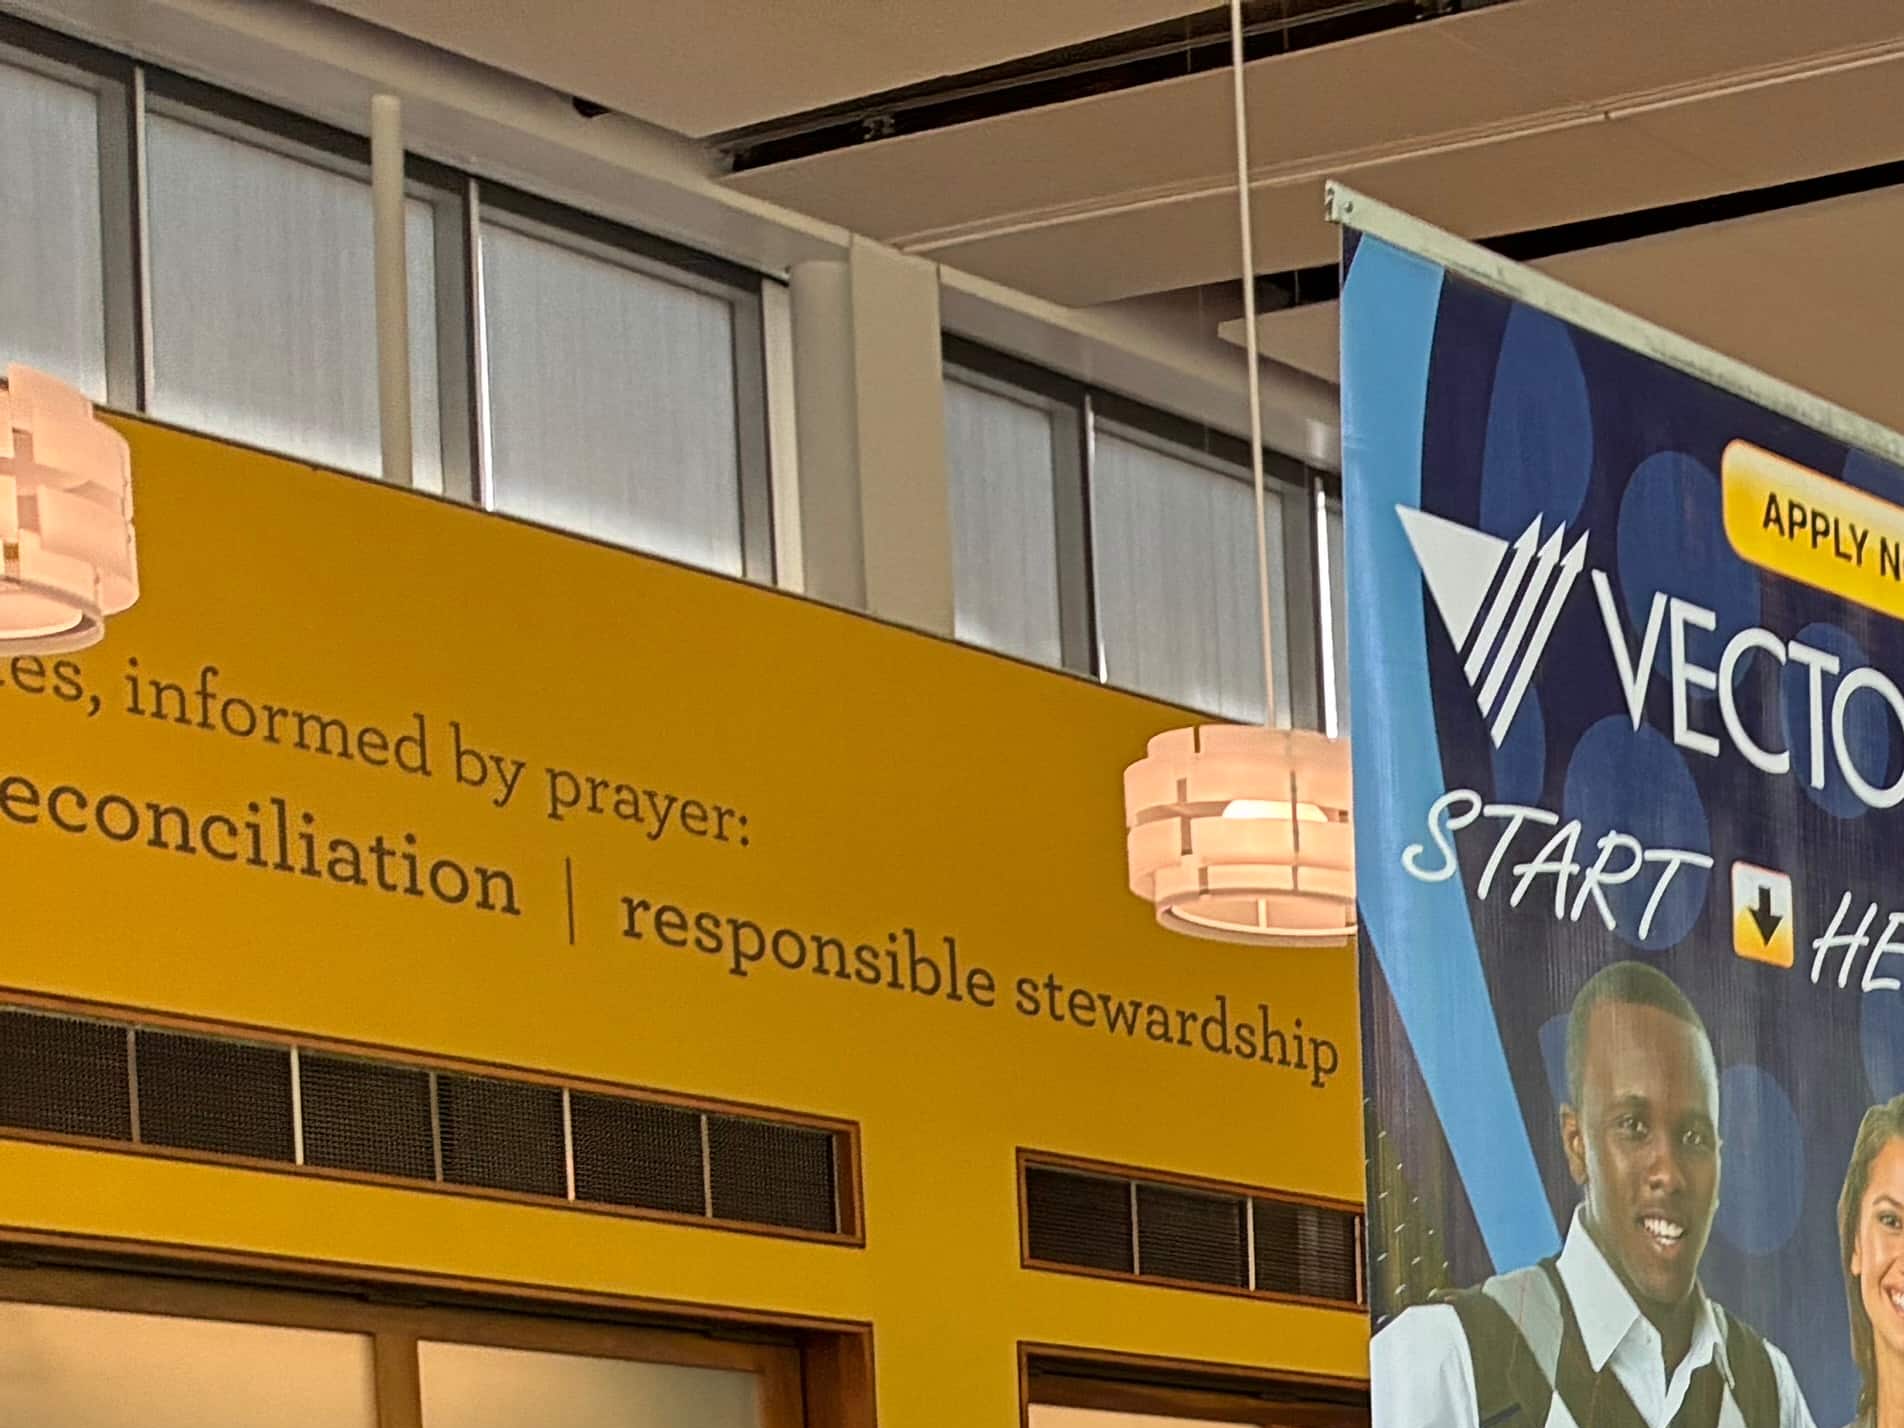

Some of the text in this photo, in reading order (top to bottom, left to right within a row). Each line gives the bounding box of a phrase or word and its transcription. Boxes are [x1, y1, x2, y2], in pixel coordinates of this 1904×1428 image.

[1762, 493, 1869, 568] APPLY
[0, 655, 752, 847] es, informed by prayer:
[1402, 788, 1715, 942] START
[620, 886, 998, 1009] responsible
[1014, 970, 1341, 1087] stewardship
